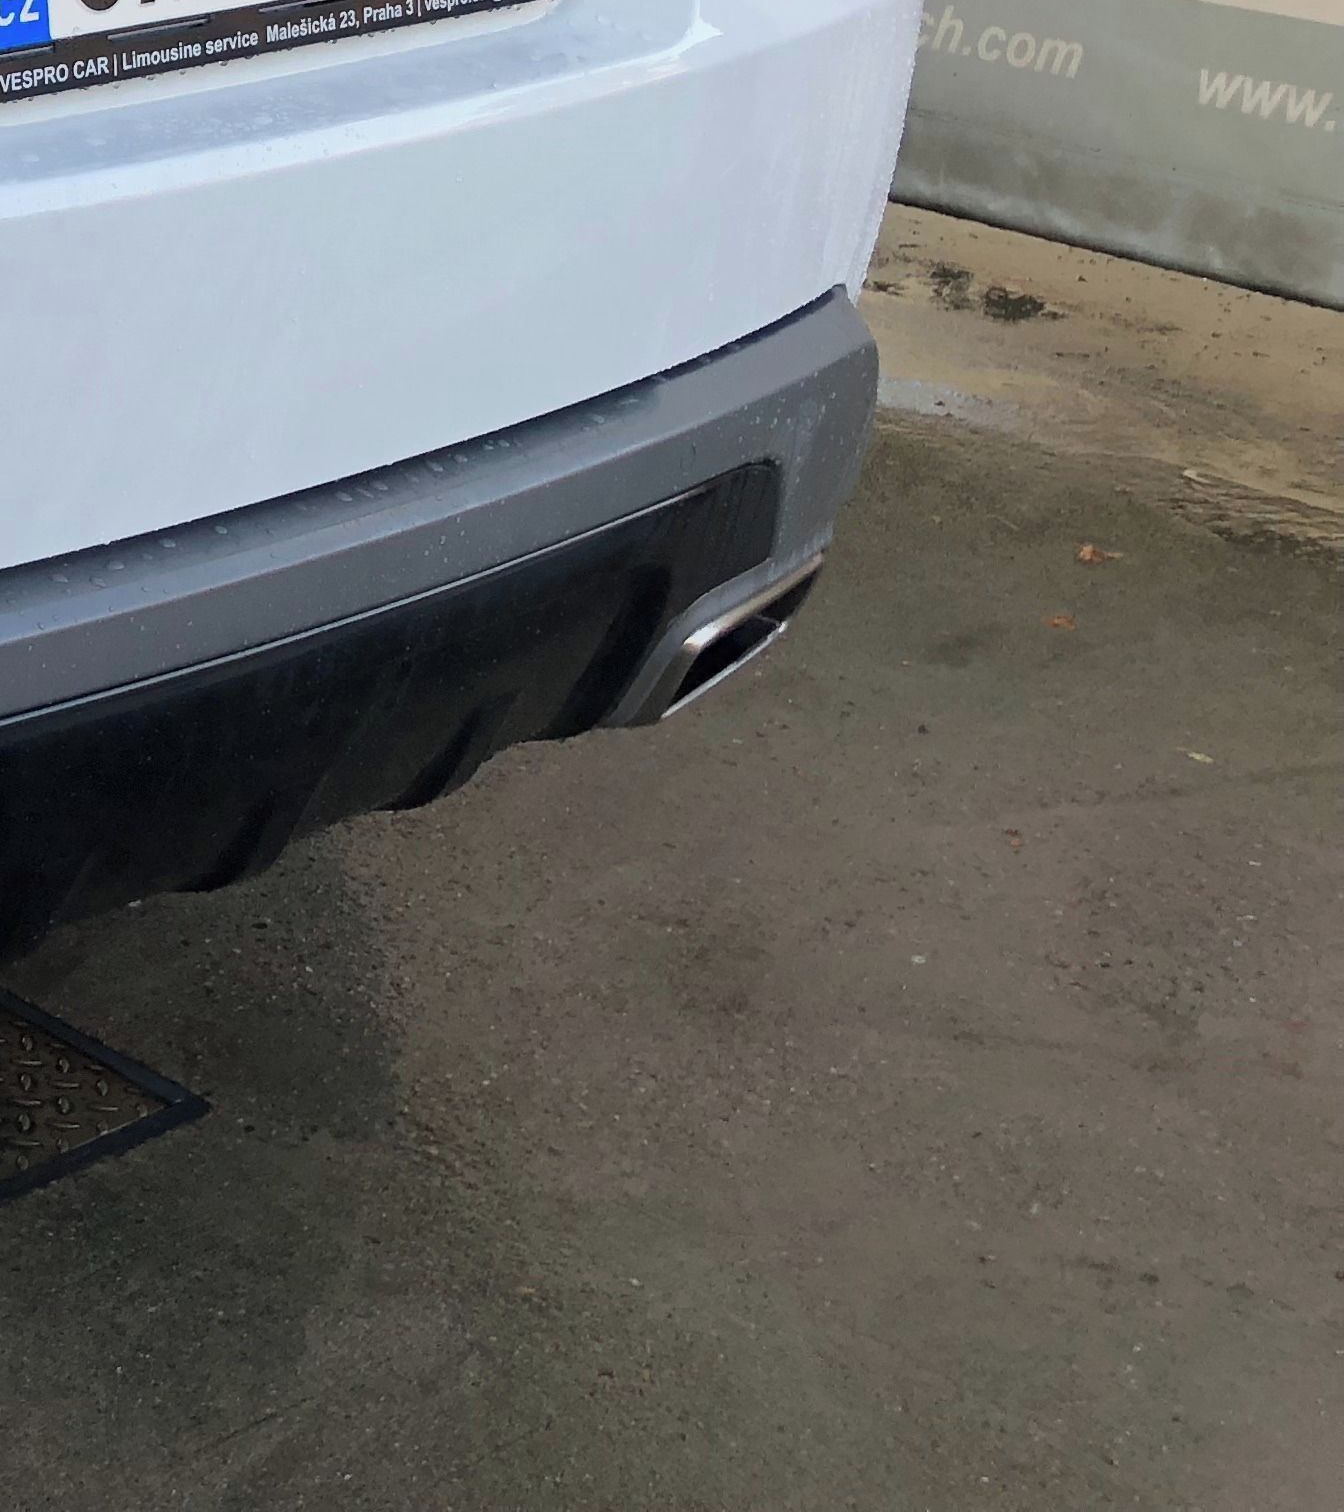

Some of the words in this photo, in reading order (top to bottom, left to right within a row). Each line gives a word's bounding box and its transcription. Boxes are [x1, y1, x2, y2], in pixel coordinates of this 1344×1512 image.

[73, 56, 110, 80] CAR
[121, 40, 202, 72] Limousine
[205, 31, 259, 55] service
[266, 12, 337, 44] Malešická
[339, 9, 360, 30] 23,
[363, 2, 403, 25] Praha
[1197, 67, 1338, 132] www.
